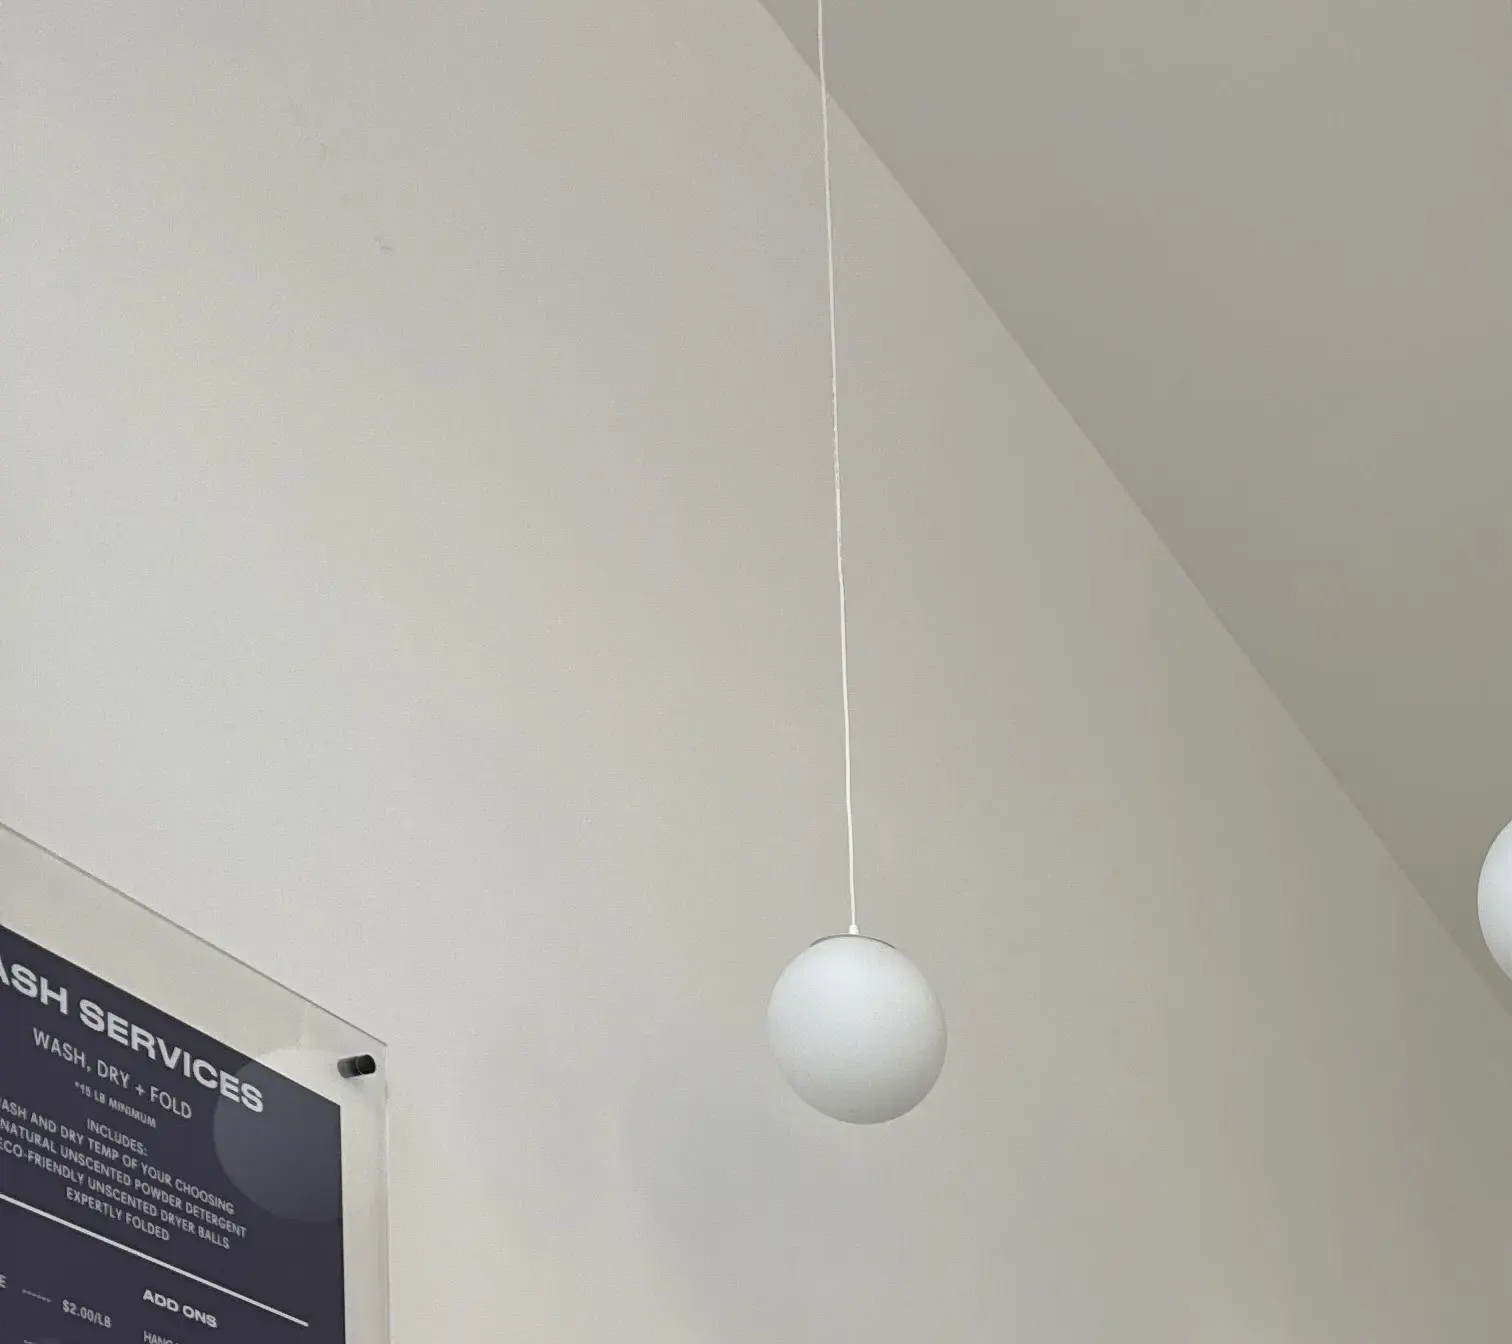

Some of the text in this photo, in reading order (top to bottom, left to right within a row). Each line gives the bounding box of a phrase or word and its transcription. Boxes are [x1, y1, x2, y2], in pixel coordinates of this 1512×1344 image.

[33, 1027, 192, 1120] WASH, DRY FOLD
[79, 999, 264, 1113] SERVICES
[87, 1118, 148, 1156] INCLUDES:
[94, 1090, 157, 1129] LB MINIMUM
[0, 1096, 235, 1215] ASH AND DRY TEMP OF YOUR CHOOSING
[60, 1144, 132, 1187] UNSCENTED
[134, 1178, 182, 1210] POWDER
[185, 1201, 247, 1239] DETERGENT
[66, 1186, 170, 1241] EXPERTLY FOLDED
[88, 1176, 158, 1216] UNSCENTED
[160, 1208, 196, 1235] DRYER
[198, 1225, 230, 1250] BALLS
[62, 1299, 112, 1329] $2.00/LB
[143, 1289, 218, 1328] ADD ONS
